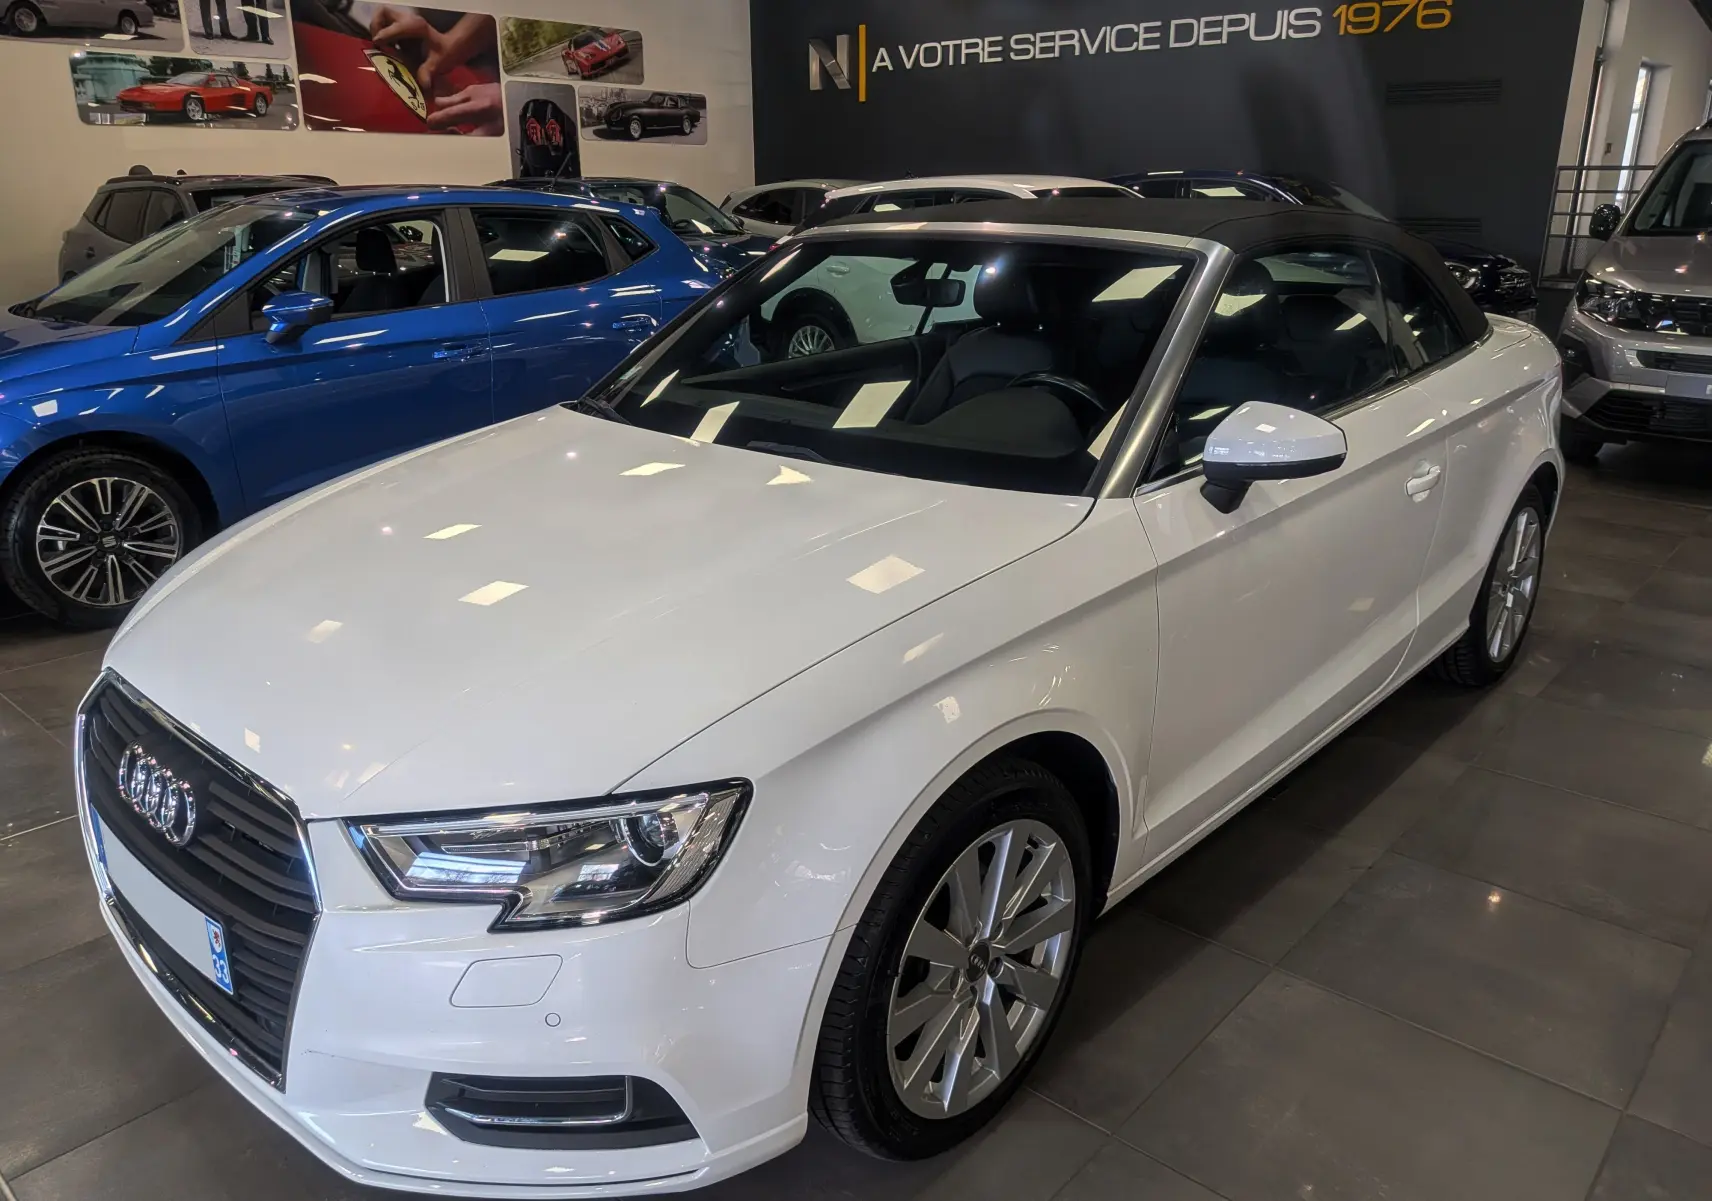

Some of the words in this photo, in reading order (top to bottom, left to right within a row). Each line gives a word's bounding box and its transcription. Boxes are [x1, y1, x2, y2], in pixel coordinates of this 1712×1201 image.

[872, 47, 894, 73] A
[898, 36, 1003, 70] VOTRE
[1009, 21, 1162, 61] SERVICE
[1169, 7, 1322, 48] DEPUIS
[1332, 0, 1453, 36] 1976
[212, 953, 230, 984] 33
